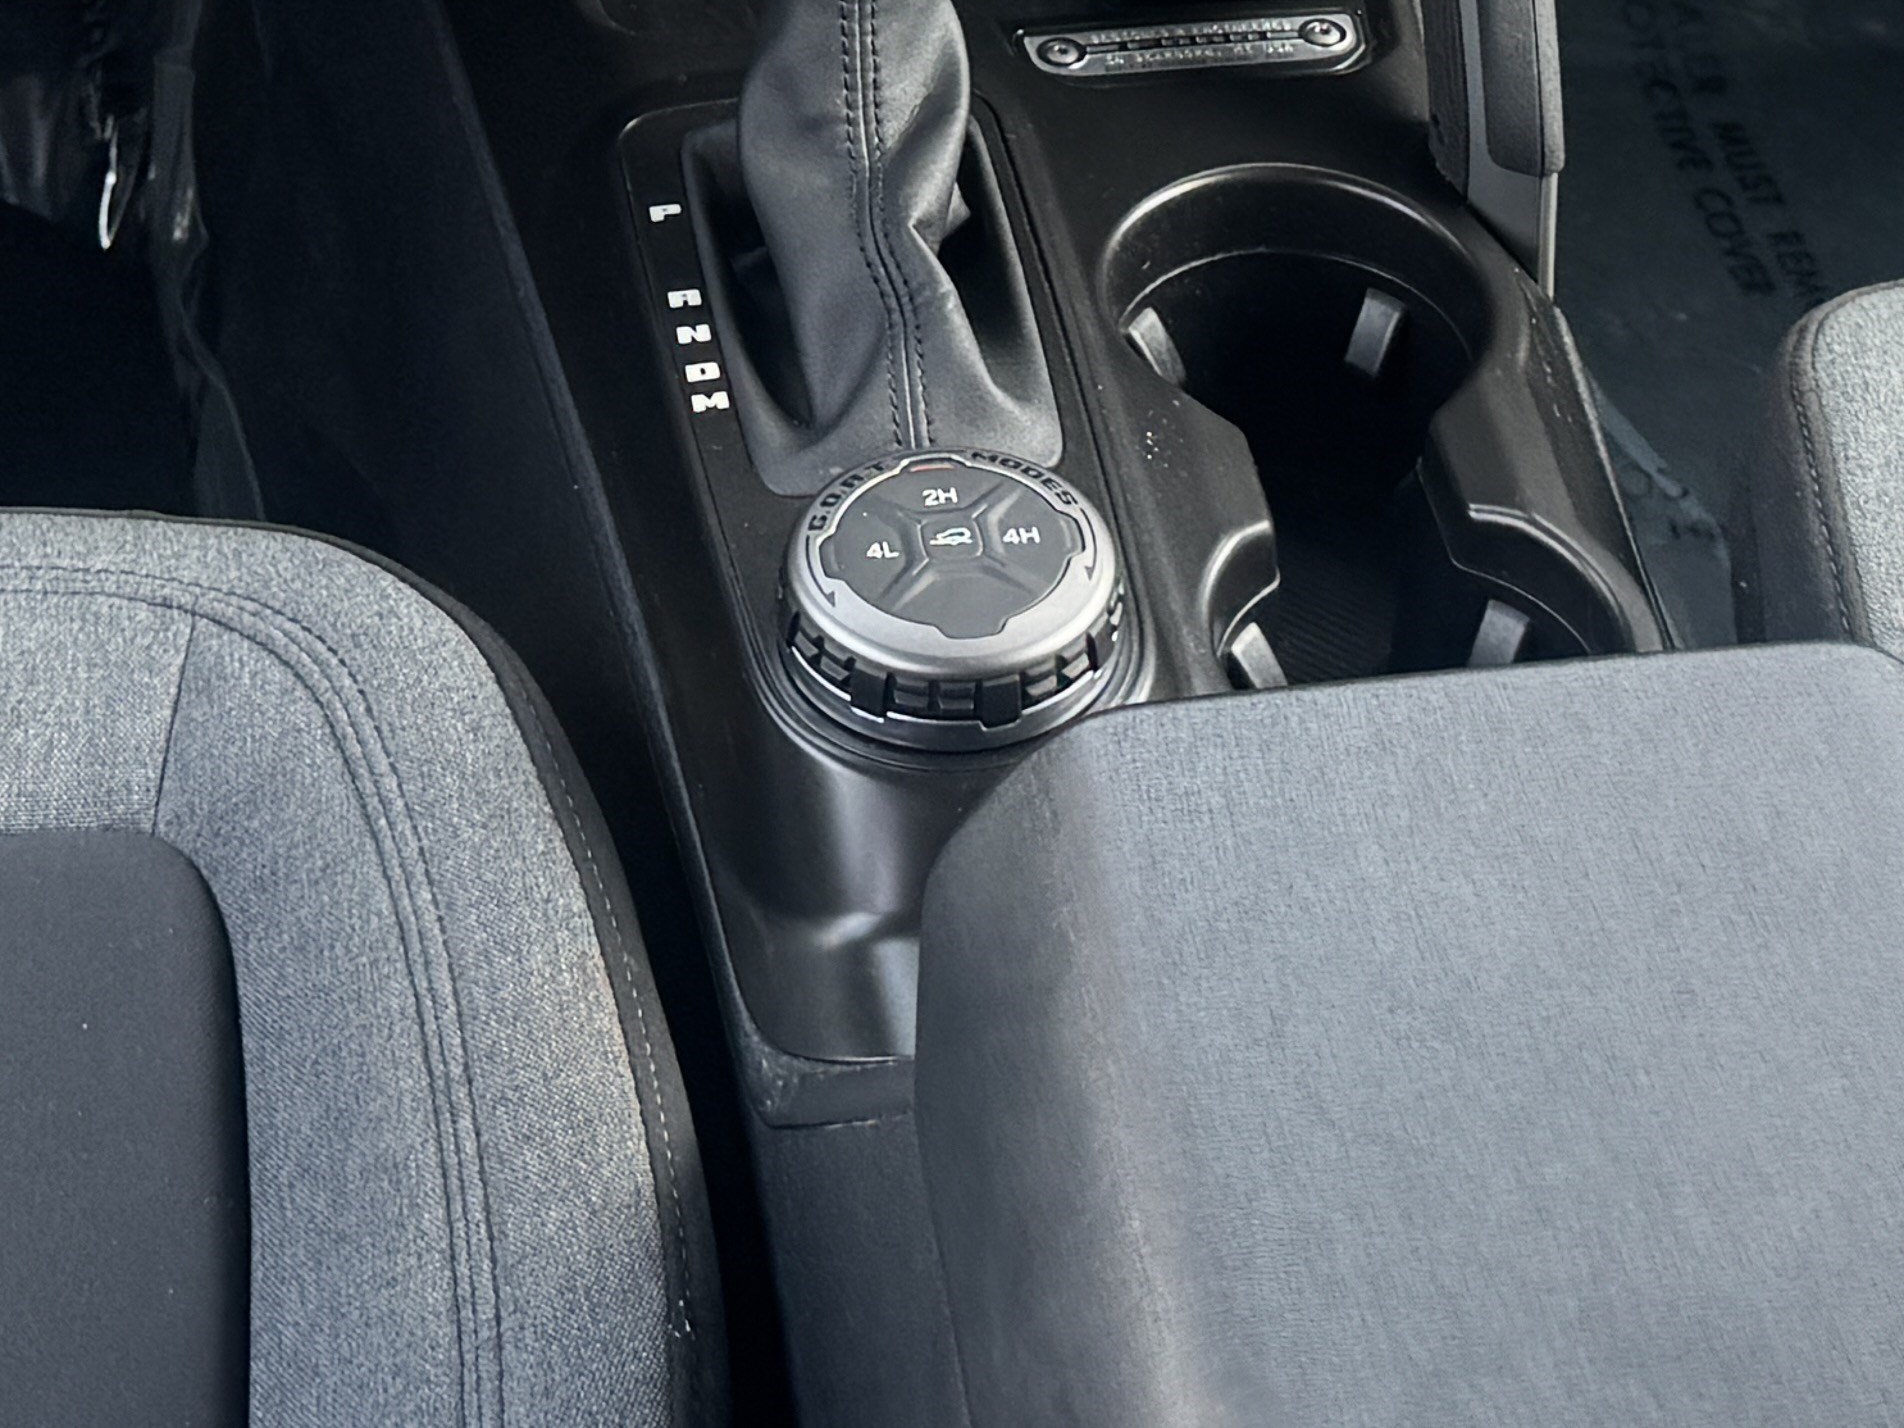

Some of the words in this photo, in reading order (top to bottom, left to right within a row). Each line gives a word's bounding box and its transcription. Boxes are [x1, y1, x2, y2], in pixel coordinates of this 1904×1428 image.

[1709, 120, 1786, 208] MUST
[649, 203, 682, 223] P
[1692, 184, 1777, 296] COVER
[676, 323, 712, 344] N
[684, 361, 721, 383] D
[691, 390, 730, 413] M
[969, 450, 1079, 507] MODES
[922, 487, 958, 507] 2H
[1003, 526, 1041, 544] 4H
[865, 541, 900, 559] 4L
